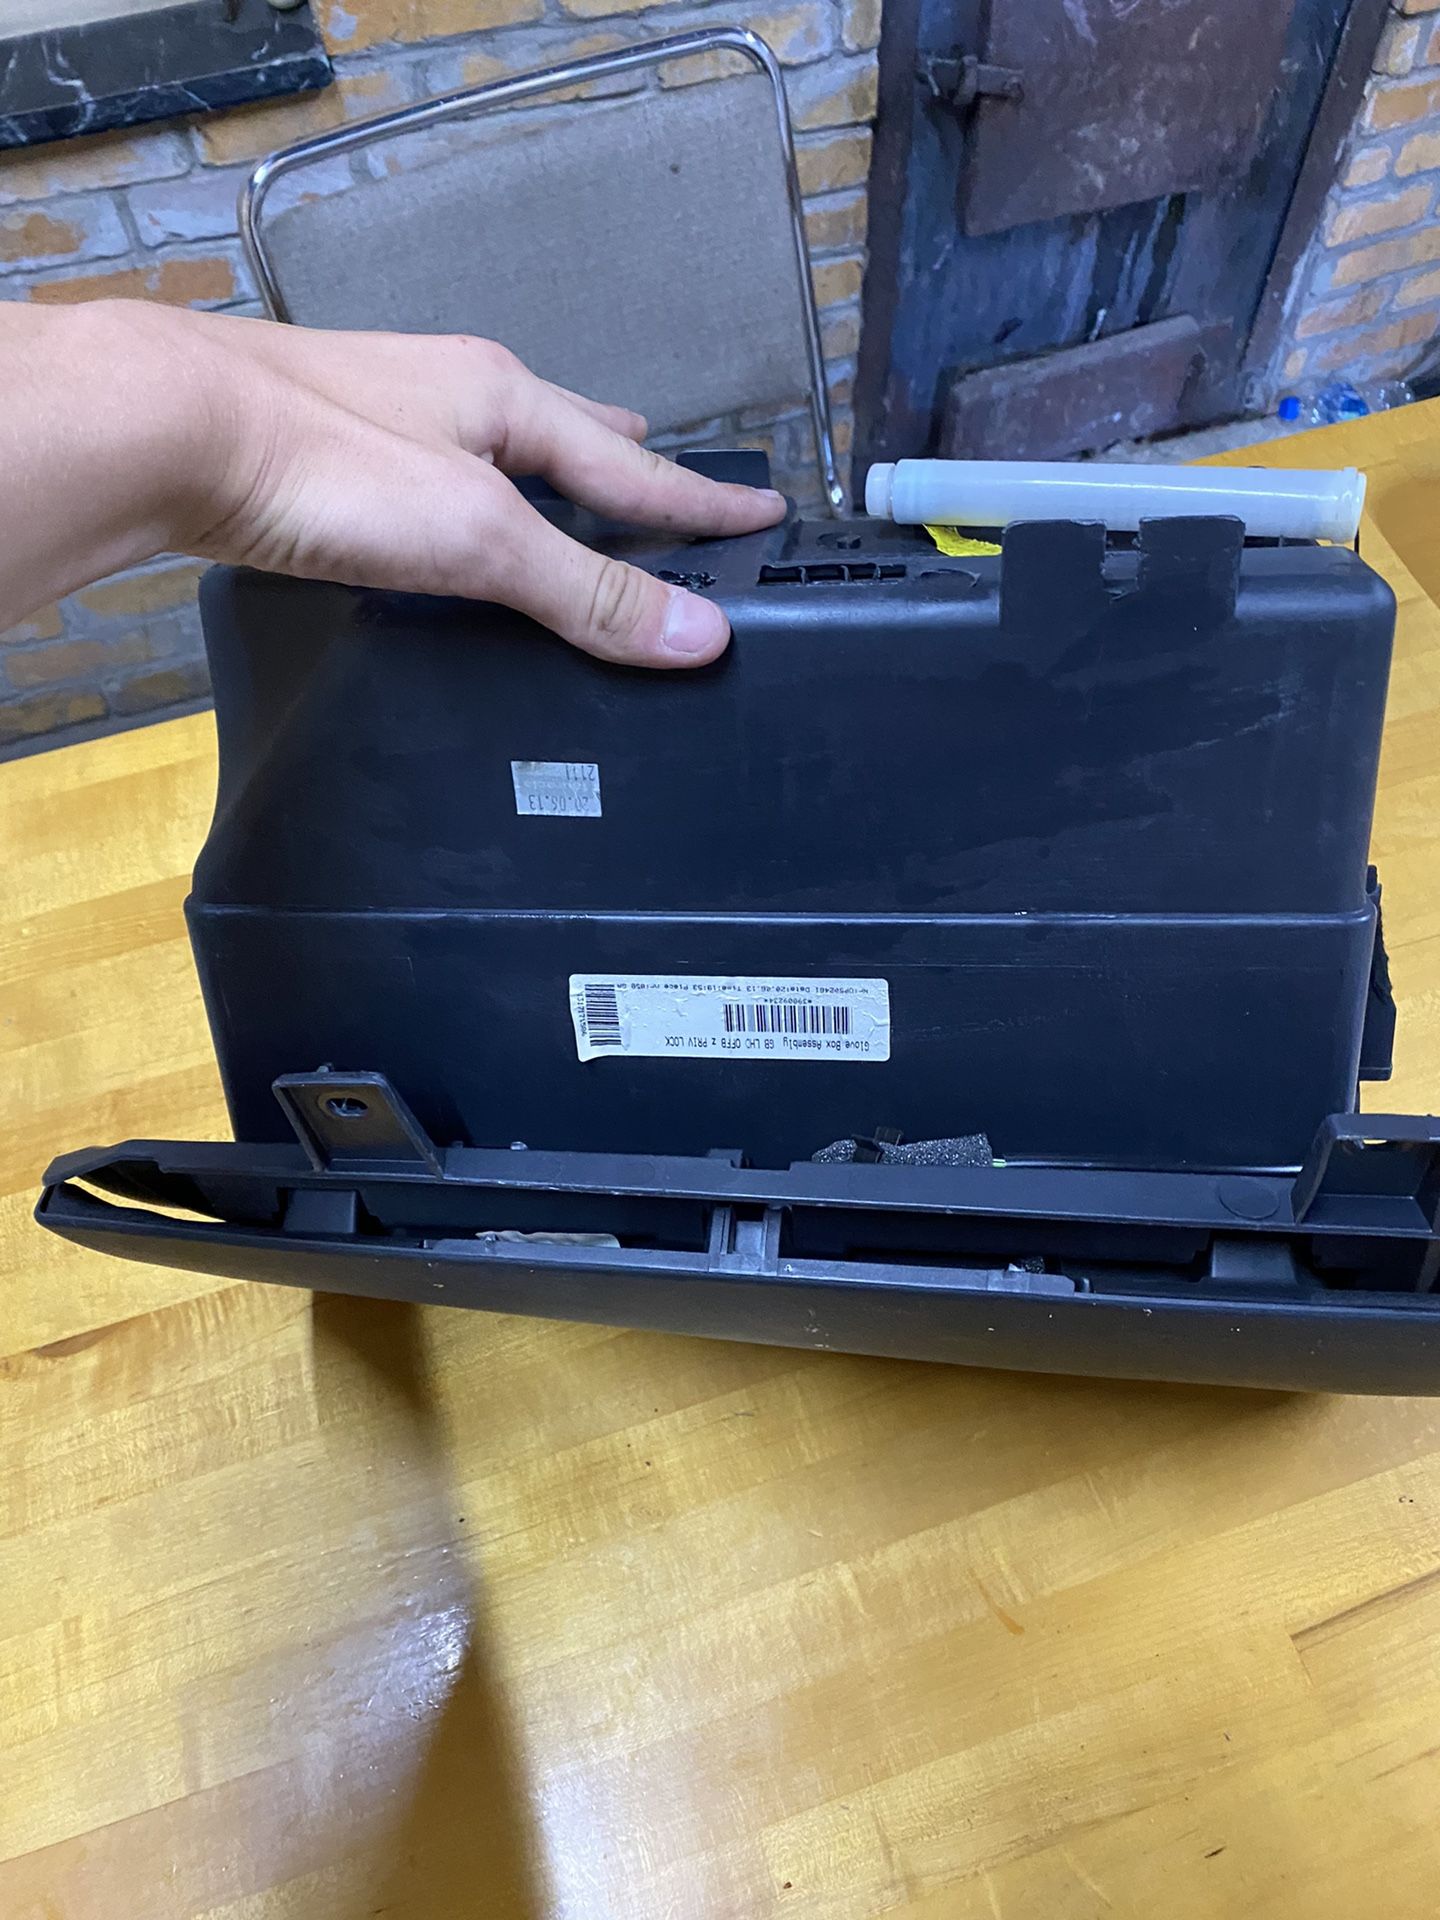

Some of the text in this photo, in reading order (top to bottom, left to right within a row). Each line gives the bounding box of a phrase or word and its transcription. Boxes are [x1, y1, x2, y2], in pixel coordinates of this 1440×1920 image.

[665, 1035, 685, 1047] LOCK
[688, 1036, 708, 1048] PRIV
[721, 1037, 741, 1049] OFFB
[783, 1036, 822, 1050] Assembly
[826, 1041, 841, 1051] Box
[845, 1040, 870, 1052] Glove
